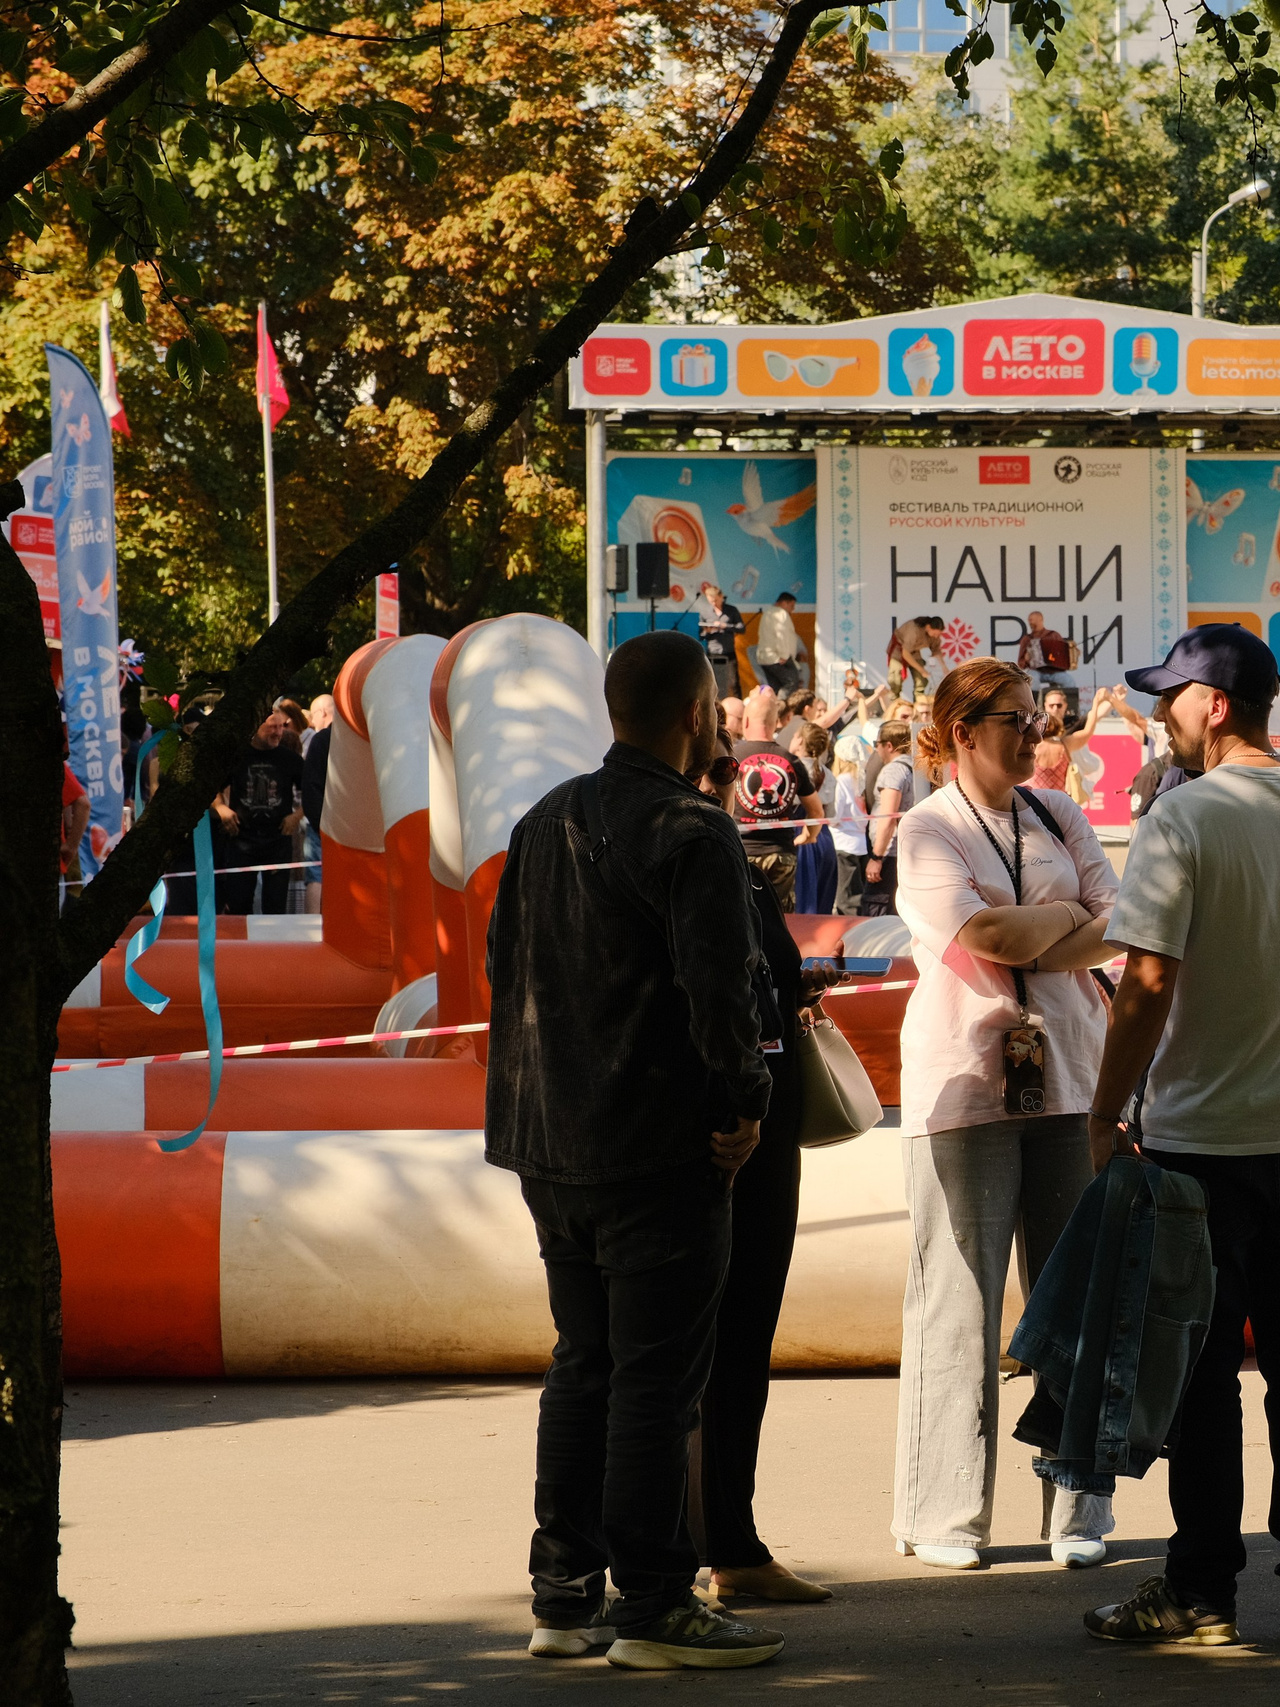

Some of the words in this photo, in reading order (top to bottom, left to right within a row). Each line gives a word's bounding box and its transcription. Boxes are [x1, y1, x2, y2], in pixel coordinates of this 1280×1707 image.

[983, 334, 1086, 362] ЛЕТО
[982, 365, 996, 379] В
[1001, 364, 1085, 379] МОСКВЕ
[987, 462, 1023, 472] ЛЕТО
[888, 502, 970, 513] ФЕСТИВАЛЬ
[972, 499, 1084, 514] ТРАДИЦИОННОЙ
[889, 514, 953, 528] РУССКОЙ
[955, 516, 1025, 528] КУЛЬТУРЫ
[891, 545, 1122, 603] НАШИ
[74, 646, 91, 667] В
[77, 675, 105, 798] МОСКВЕ
